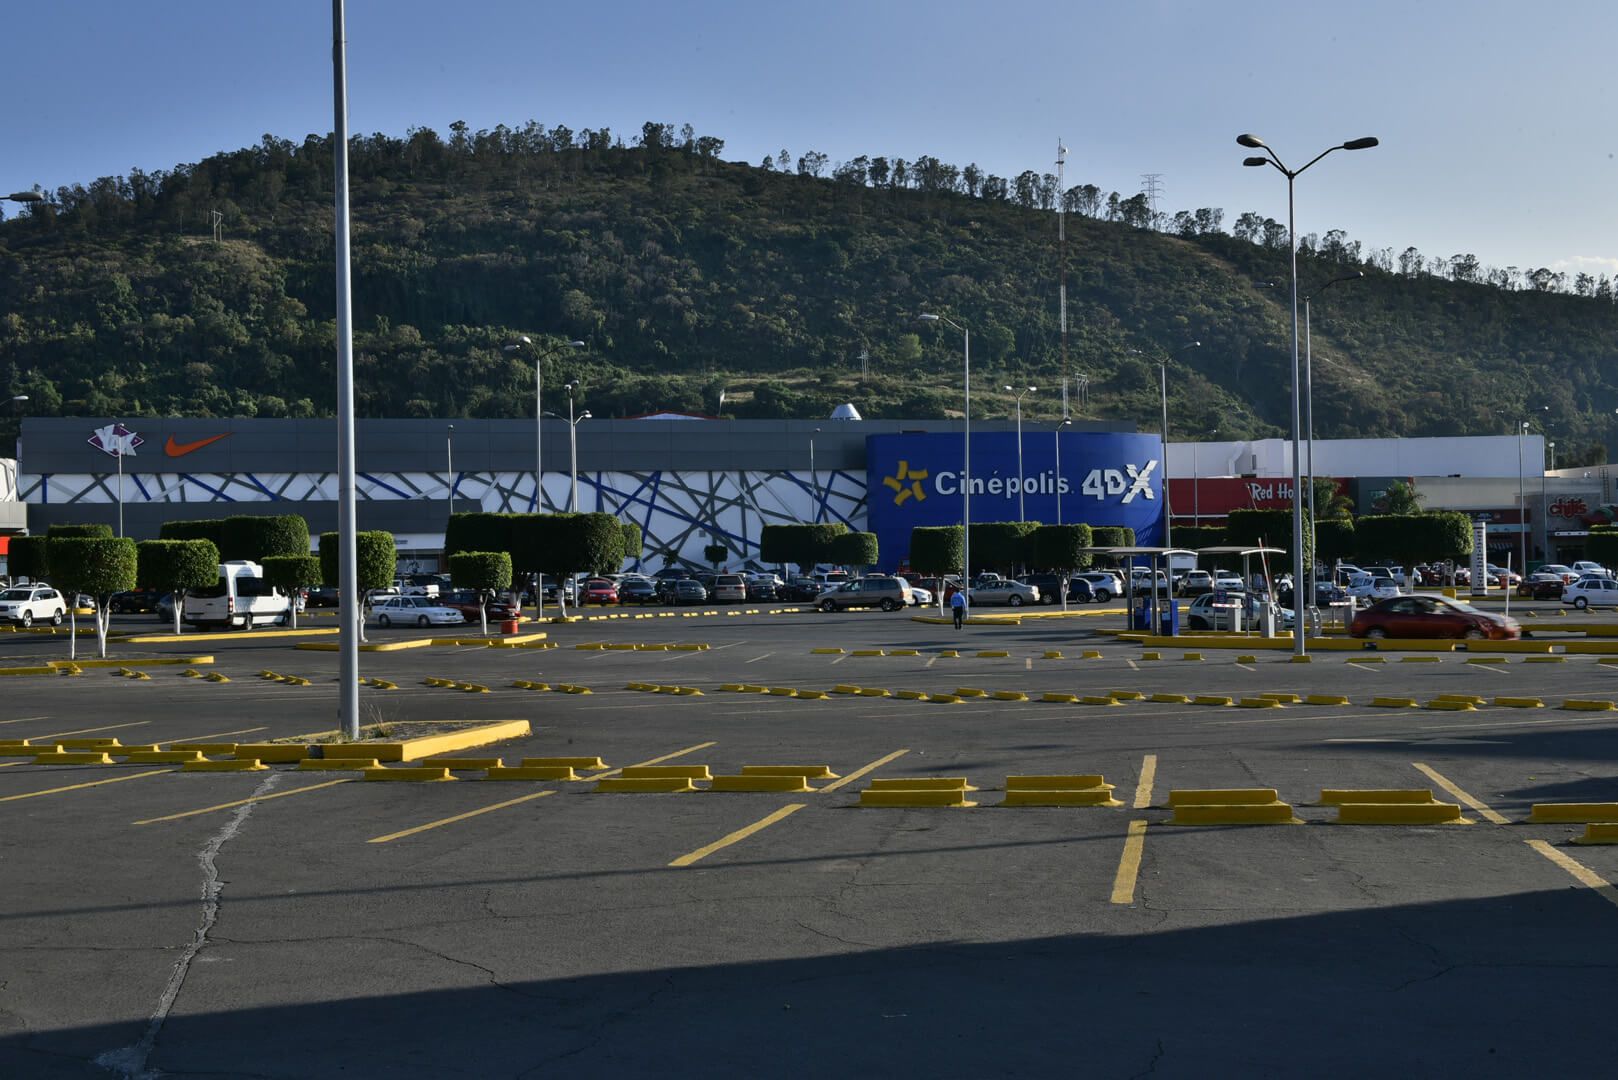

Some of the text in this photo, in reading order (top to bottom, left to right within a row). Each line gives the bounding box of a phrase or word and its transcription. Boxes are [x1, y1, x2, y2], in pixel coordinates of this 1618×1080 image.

[935, 460, 1158, 503] Cinépolis 4DX
[1250, 483, 1294, 501] Red Ho
